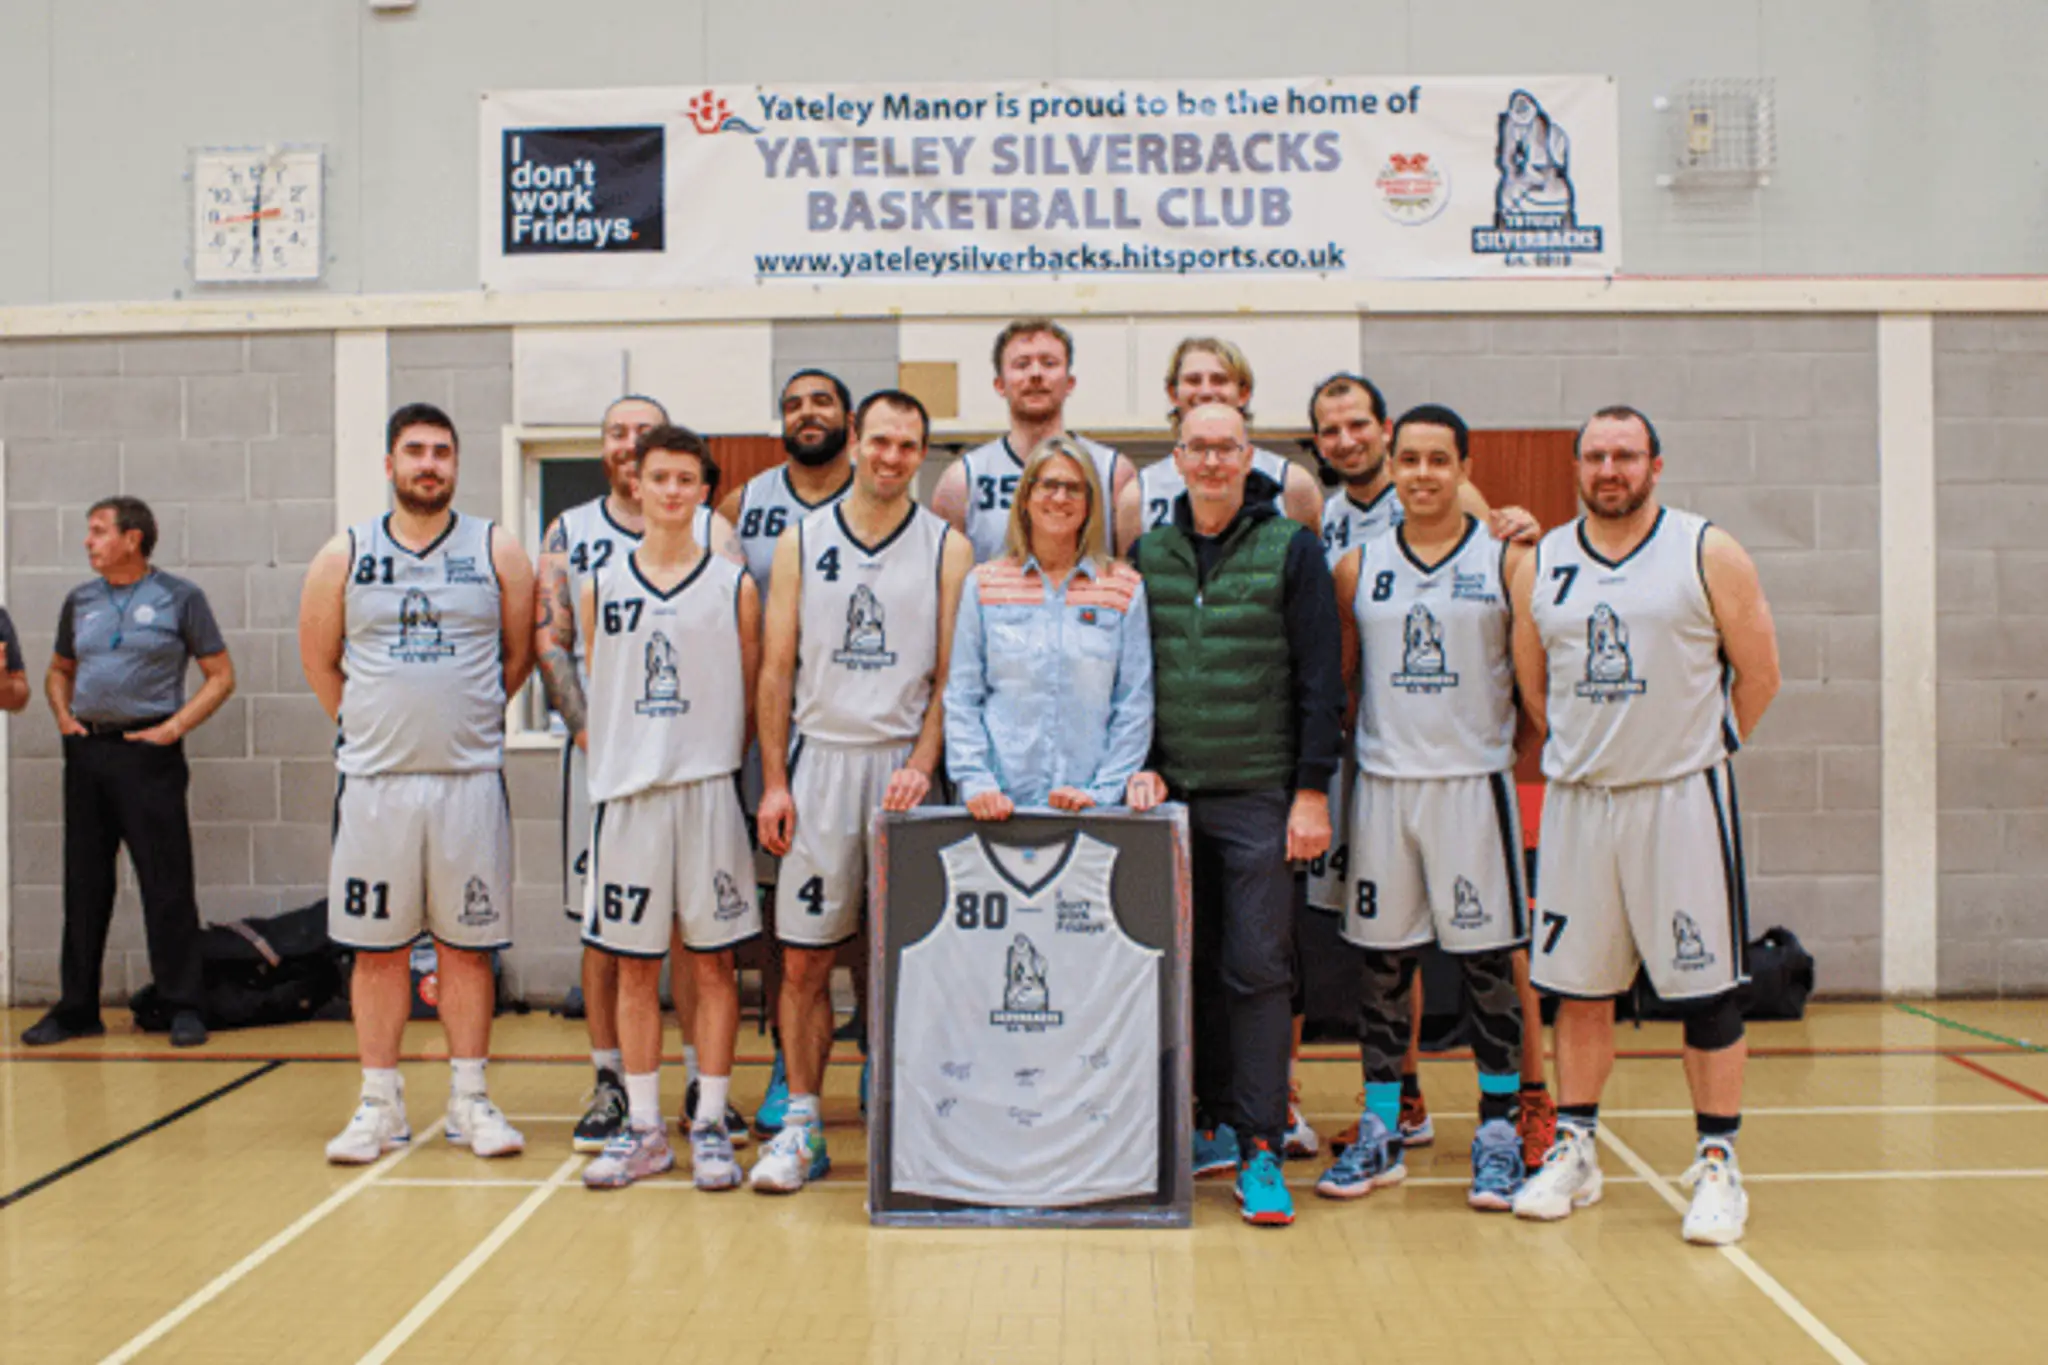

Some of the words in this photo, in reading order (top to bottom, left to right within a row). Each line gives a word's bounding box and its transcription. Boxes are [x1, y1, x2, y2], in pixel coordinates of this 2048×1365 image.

[757, 93, 873, 126] Yateley
[883, 93, 988, 121] Manor
[996, 92, 1020, 119] is
[1029, 90, 1125, 123] proud
[1135, 91, 1168, 117] to
[1176, 89, 1218, 116] be
[1225, 88, 1279, 115] the
[1286, 87, 1378, 115] home
[1386, 86, 1421, 115] of
[511, 135, 522, 165] I
[755, 135, 976, 178] YATELEY
[991, 131, 1343, 177] SILVERBACKS
[511, 160, 596, 189] don't
[511, 184, 594, 214] work
[807, 187, 1142, 232] BASKETBALL
[1156, 186, 1293, 228] CLUB
[754, 241, 1346, 278] www.yateleysilverbacks.hitsports.co.uk
[977, 474, 1020, 510] 35
[741, 507, 788, 539] 86
[355, 555, 395, 585] 81
[570, 539, 613, 573] 42
[816, 546, 841, 582] 4
[1372, 570, 1395, 601] 8
[1552, 565, 1579, 605] 7
[604, 598, 645, 635] 67
[345, 877, 391, 920] 81
[603, 884, 652, 924] 67
[798, 875, 825, 915] 4
[955, 891, 1008, 930] 80
[1357, 879, 1378, 919] 8
[1542, 911, 1569, 955] 7
